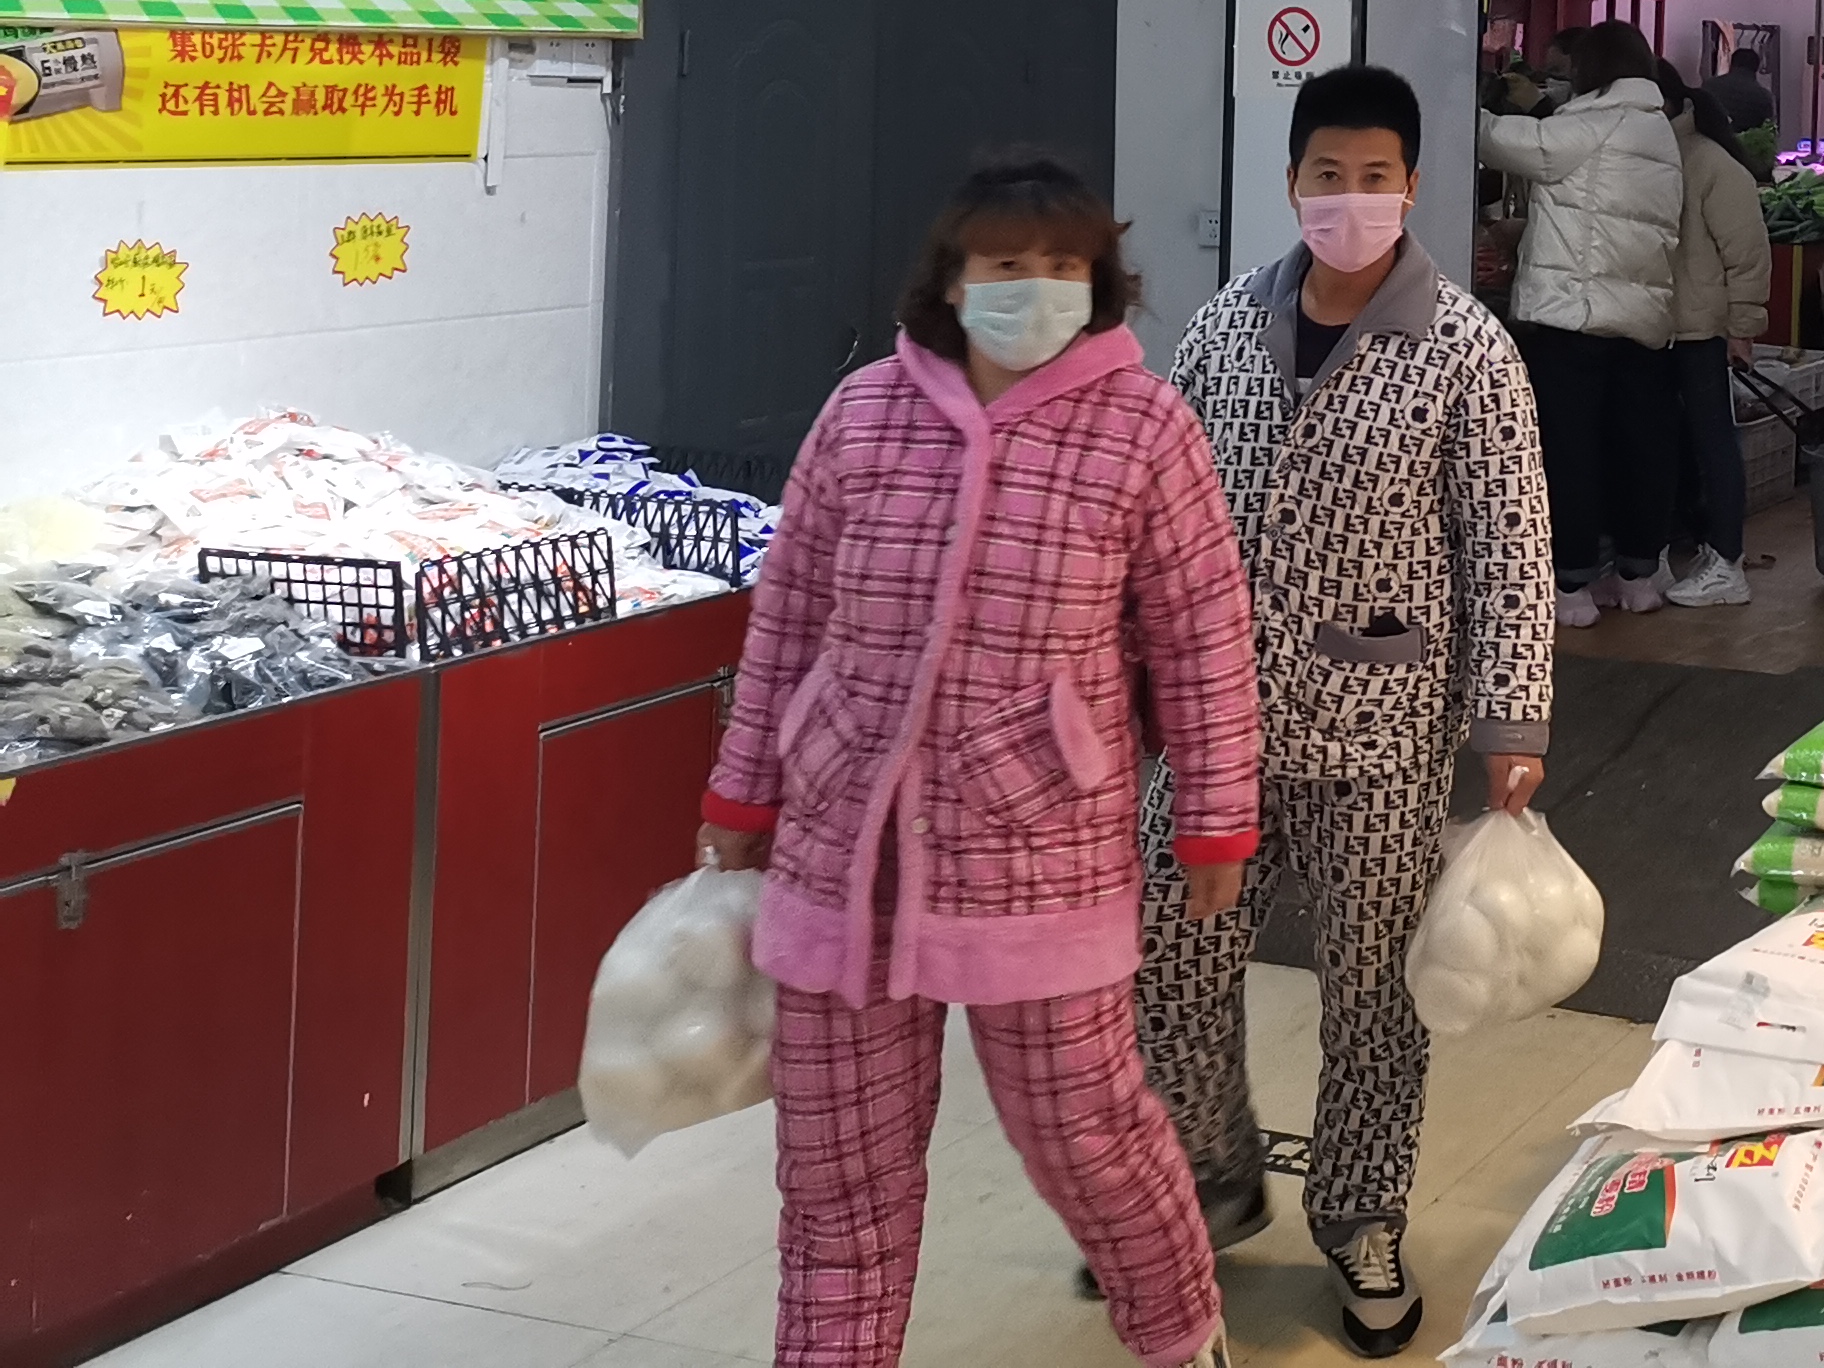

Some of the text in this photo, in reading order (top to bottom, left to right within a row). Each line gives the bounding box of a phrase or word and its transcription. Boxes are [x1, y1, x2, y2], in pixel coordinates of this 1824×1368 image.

[167, 29, 462, 69] 集6张卡片兑换本品1袋
[158, 78, 458, 118] 还有机会赢取华为手机
